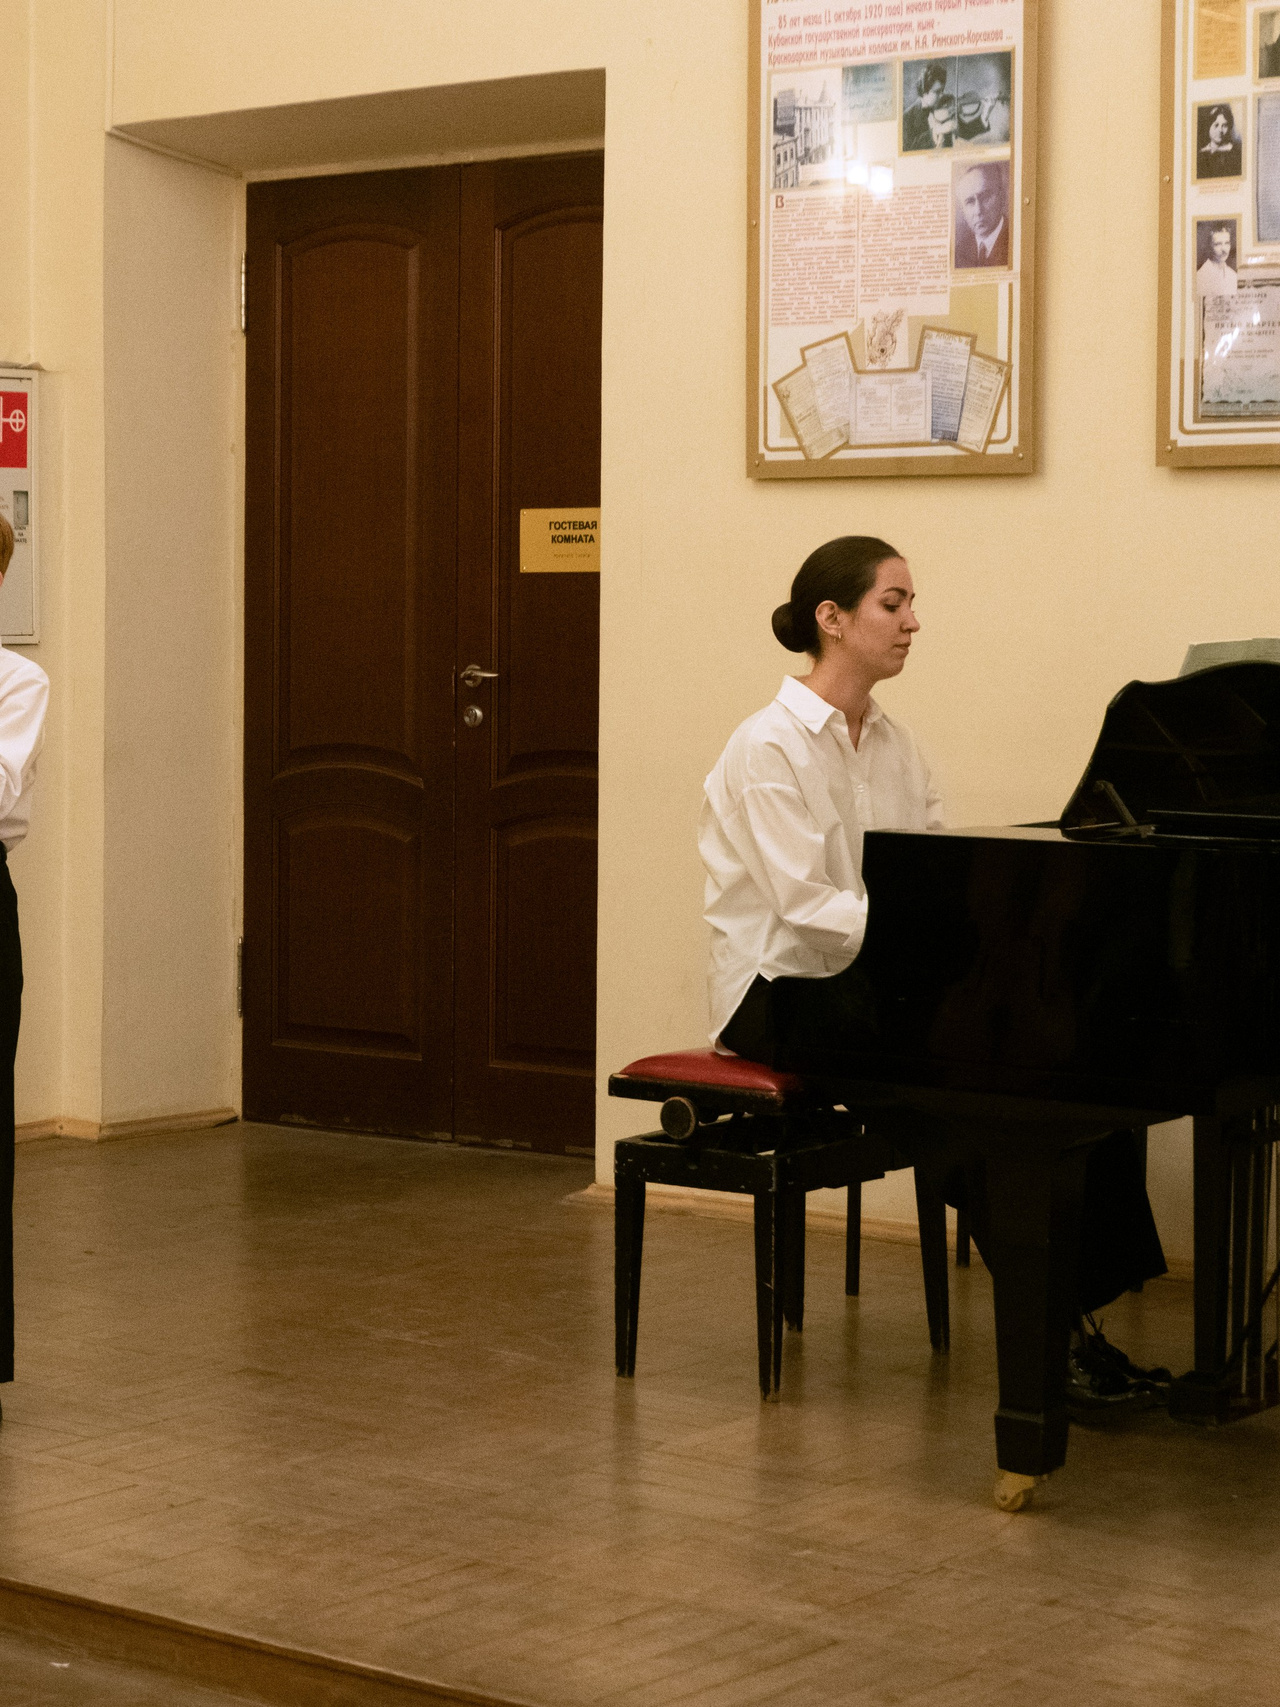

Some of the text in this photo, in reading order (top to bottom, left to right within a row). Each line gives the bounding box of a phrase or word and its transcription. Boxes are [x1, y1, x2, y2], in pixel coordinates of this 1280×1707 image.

[778, 14, 787, 29] 85
[789, 16, 801, 29] лет
[803, 14, 822, 27] назад
[834, 7, 862, 23] октября
[864, 4, 883, 19] 1920
[885, 1, 903, 17] года)
[768, 32, 803, 50] Кубанской
[805, 25, 860, 47] государственной
[862, 23, 914, 39] консерватории,
[768, 49, 818, 67] Краснодарский
[820, 42, 866, 62] музыкальный
[868, 41, 898, 55] колледж
[932, 29, 1004, 48] Римского-Корсакова
[549, 521, 598, 531] ГОСТЕВАЯ
[551, 534, 596, 544] КОМНАТА
